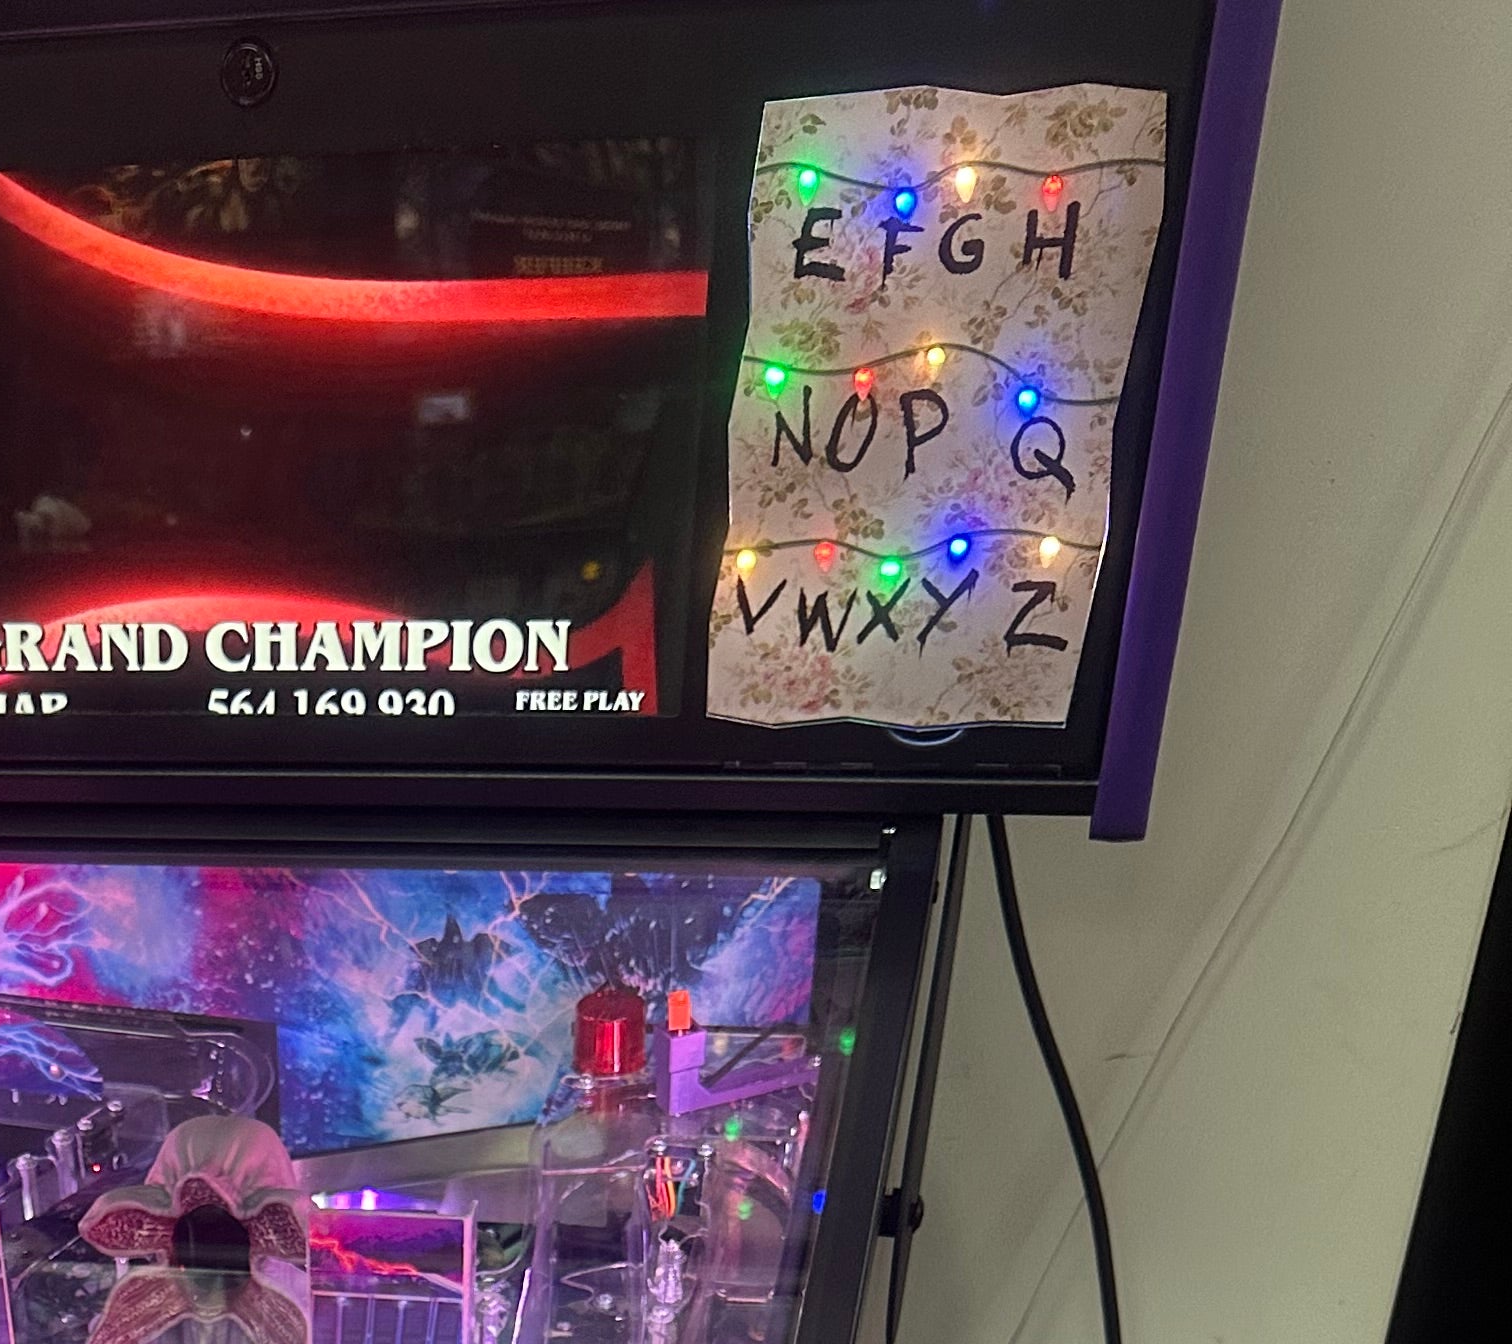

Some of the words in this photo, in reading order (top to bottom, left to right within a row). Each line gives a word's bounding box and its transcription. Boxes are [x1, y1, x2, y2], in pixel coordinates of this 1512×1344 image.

[204, 619, 572, 673] CHAMPION
[516, 690, 577, 711] FREE
[582, 690, 646, 711] PLAY
